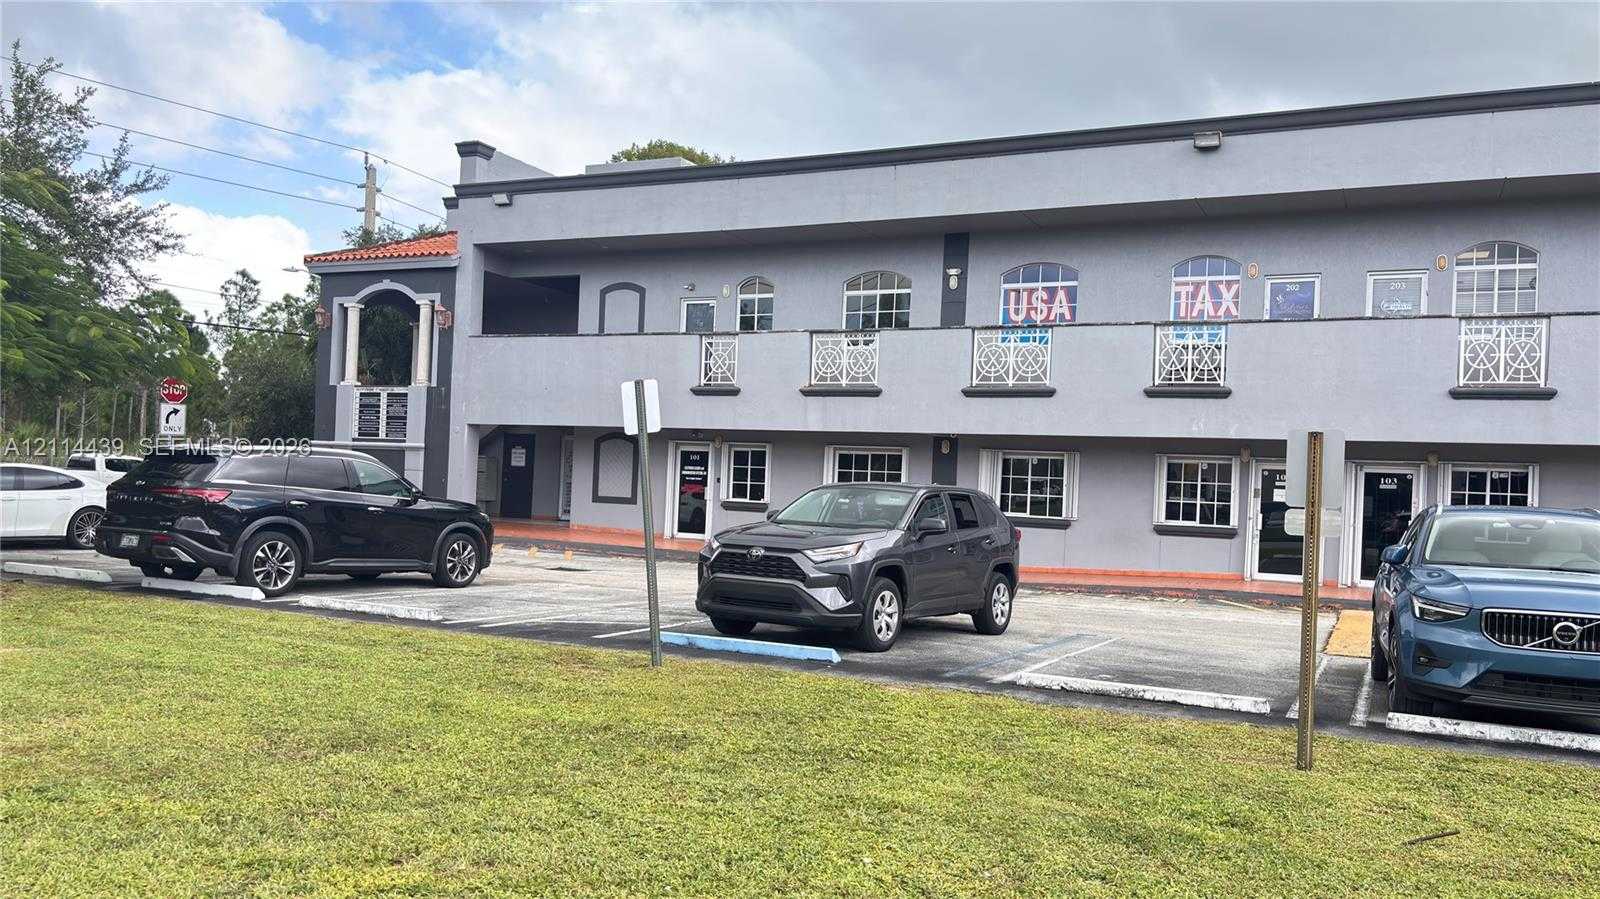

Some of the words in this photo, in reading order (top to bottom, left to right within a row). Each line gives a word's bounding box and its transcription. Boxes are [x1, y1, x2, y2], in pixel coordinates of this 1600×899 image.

[1286, 284, 1300, 292] 202
[1390, 282, 1407, 290] 203
[1008, 289, 1072, 322] USA
[1174, 282, 1240, 320] TAX
[163, 384, 186, 395] STOP
[1380, 477, 1398, 485] 103
